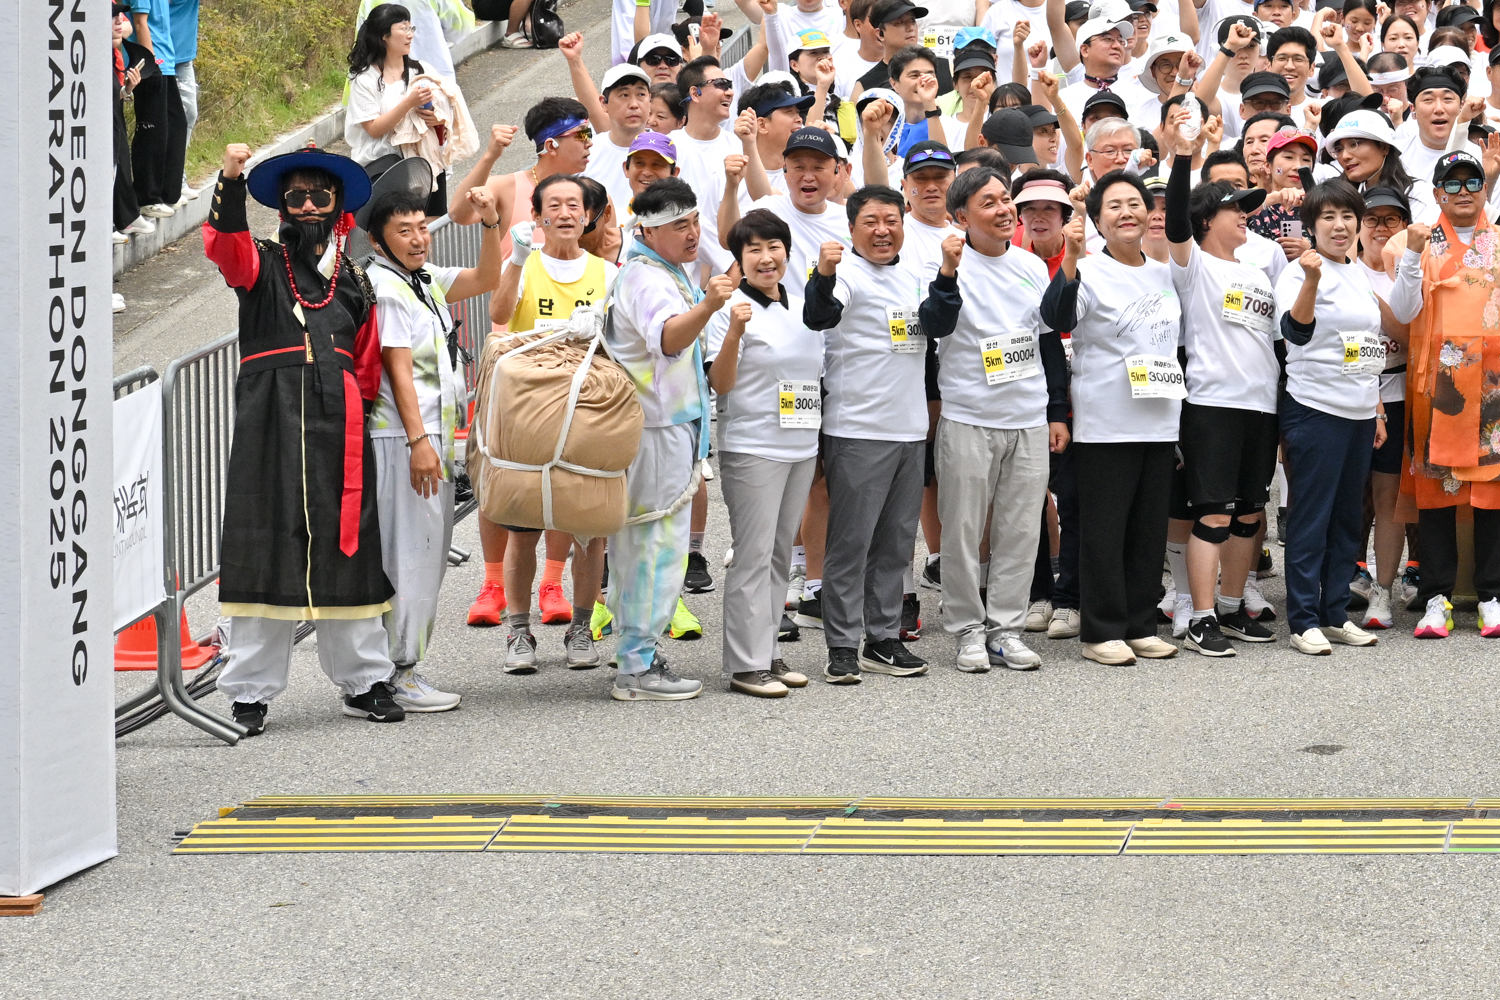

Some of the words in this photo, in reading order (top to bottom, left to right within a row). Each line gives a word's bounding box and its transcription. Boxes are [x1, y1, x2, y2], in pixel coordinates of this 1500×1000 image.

[937, 35, 956, 46] 614
[1337, 120, 1359, 130] HOKA
[793, 133, 825, 144] SRIXON
[1442, 153, 1478, 167] KOREA
[1225, 294, 1241, 306] 5km
[1244, 295, 1275, 320] 7092
[892, 326, 906, 337] 5km
[985, 357, 1003, 367] 5km
[1004, 347, 1035, 364] 30004
[1345, 347, 1359, 358] 5km
[1360, 346, 1385, 359] 30006
[1130, 371, 1147, 382] 5km
[1149, 371, 1183, 385] 30009
[780, 399, 794, 410] 5km
[70, 286, 88, 687] DONGGANG
[49, 415, 66, 590] 2025
